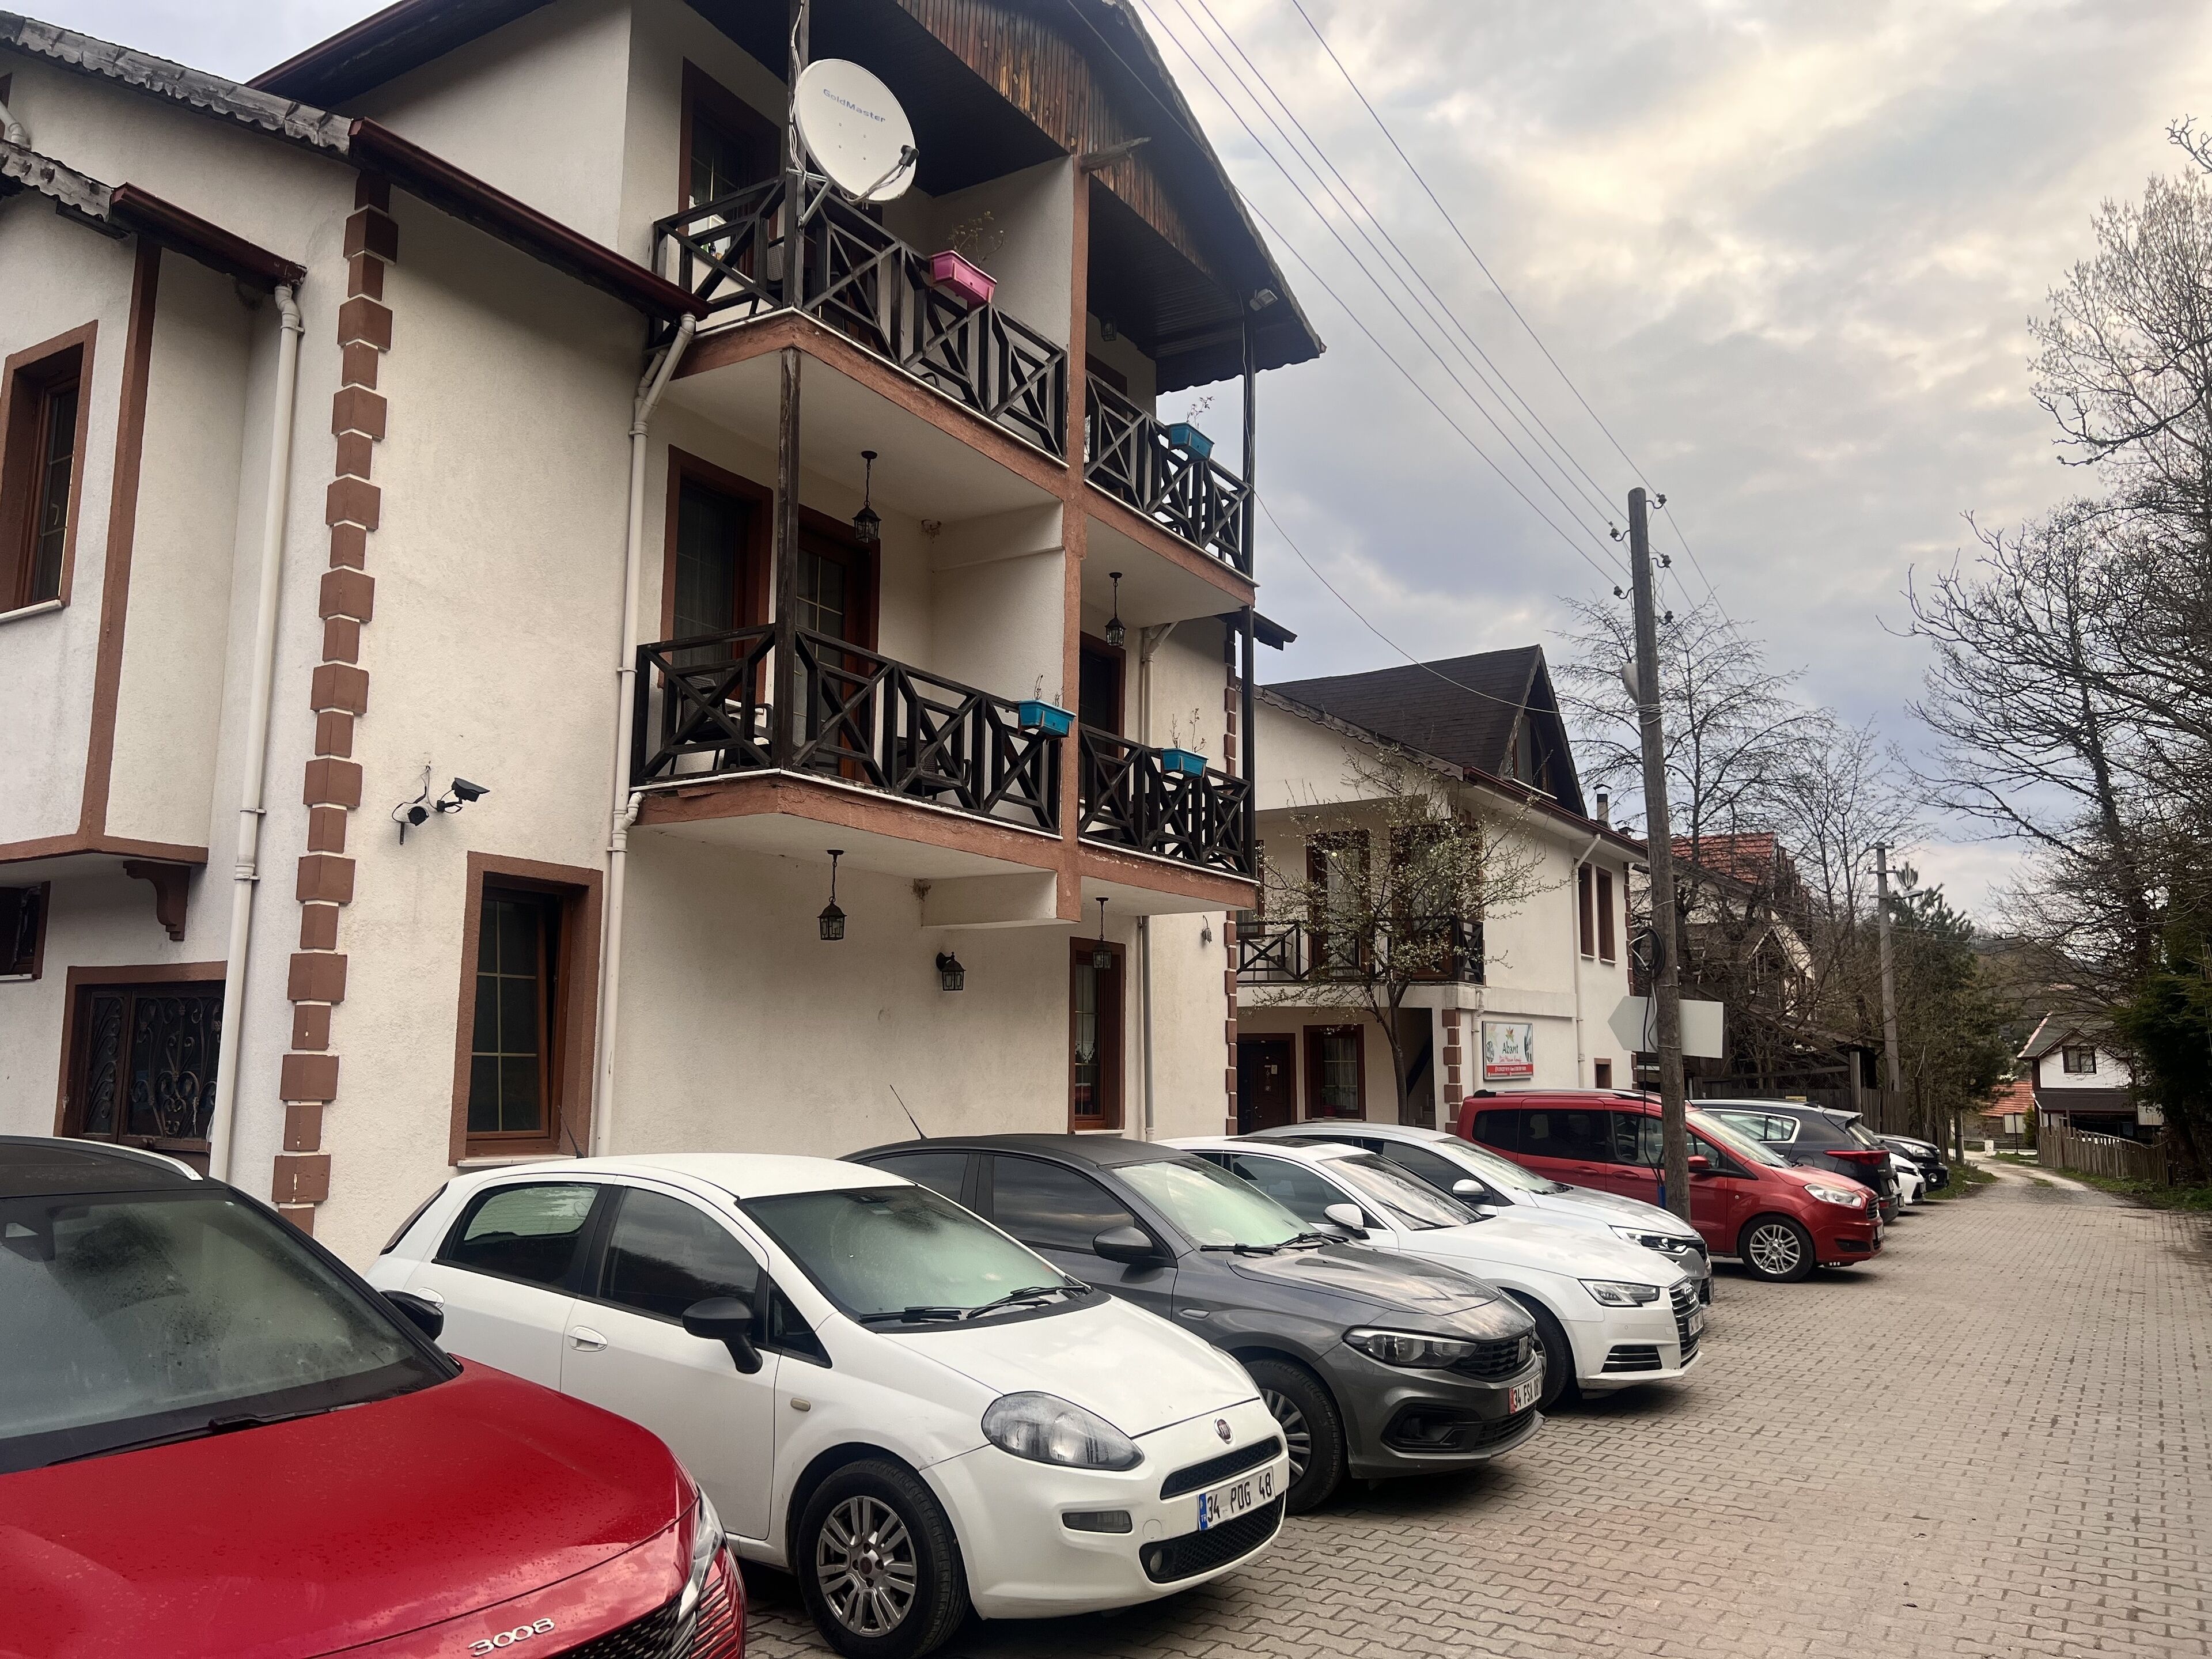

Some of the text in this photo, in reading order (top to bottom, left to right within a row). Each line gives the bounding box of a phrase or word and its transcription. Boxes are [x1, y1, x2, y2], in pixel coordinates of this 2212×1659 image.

[823, 89, 886, 123] GoldMaster
[1502, 1041, 1518, 1054] Abant
[1513, 1388, 1521, 1408] 34
[1200, 1514, 1207, 1523] TR
[1207, 1494, 1221, 1523] 34
[1259, 1472, 1272, 1500] 48
[468, 1617, 555, 1657] 3008
